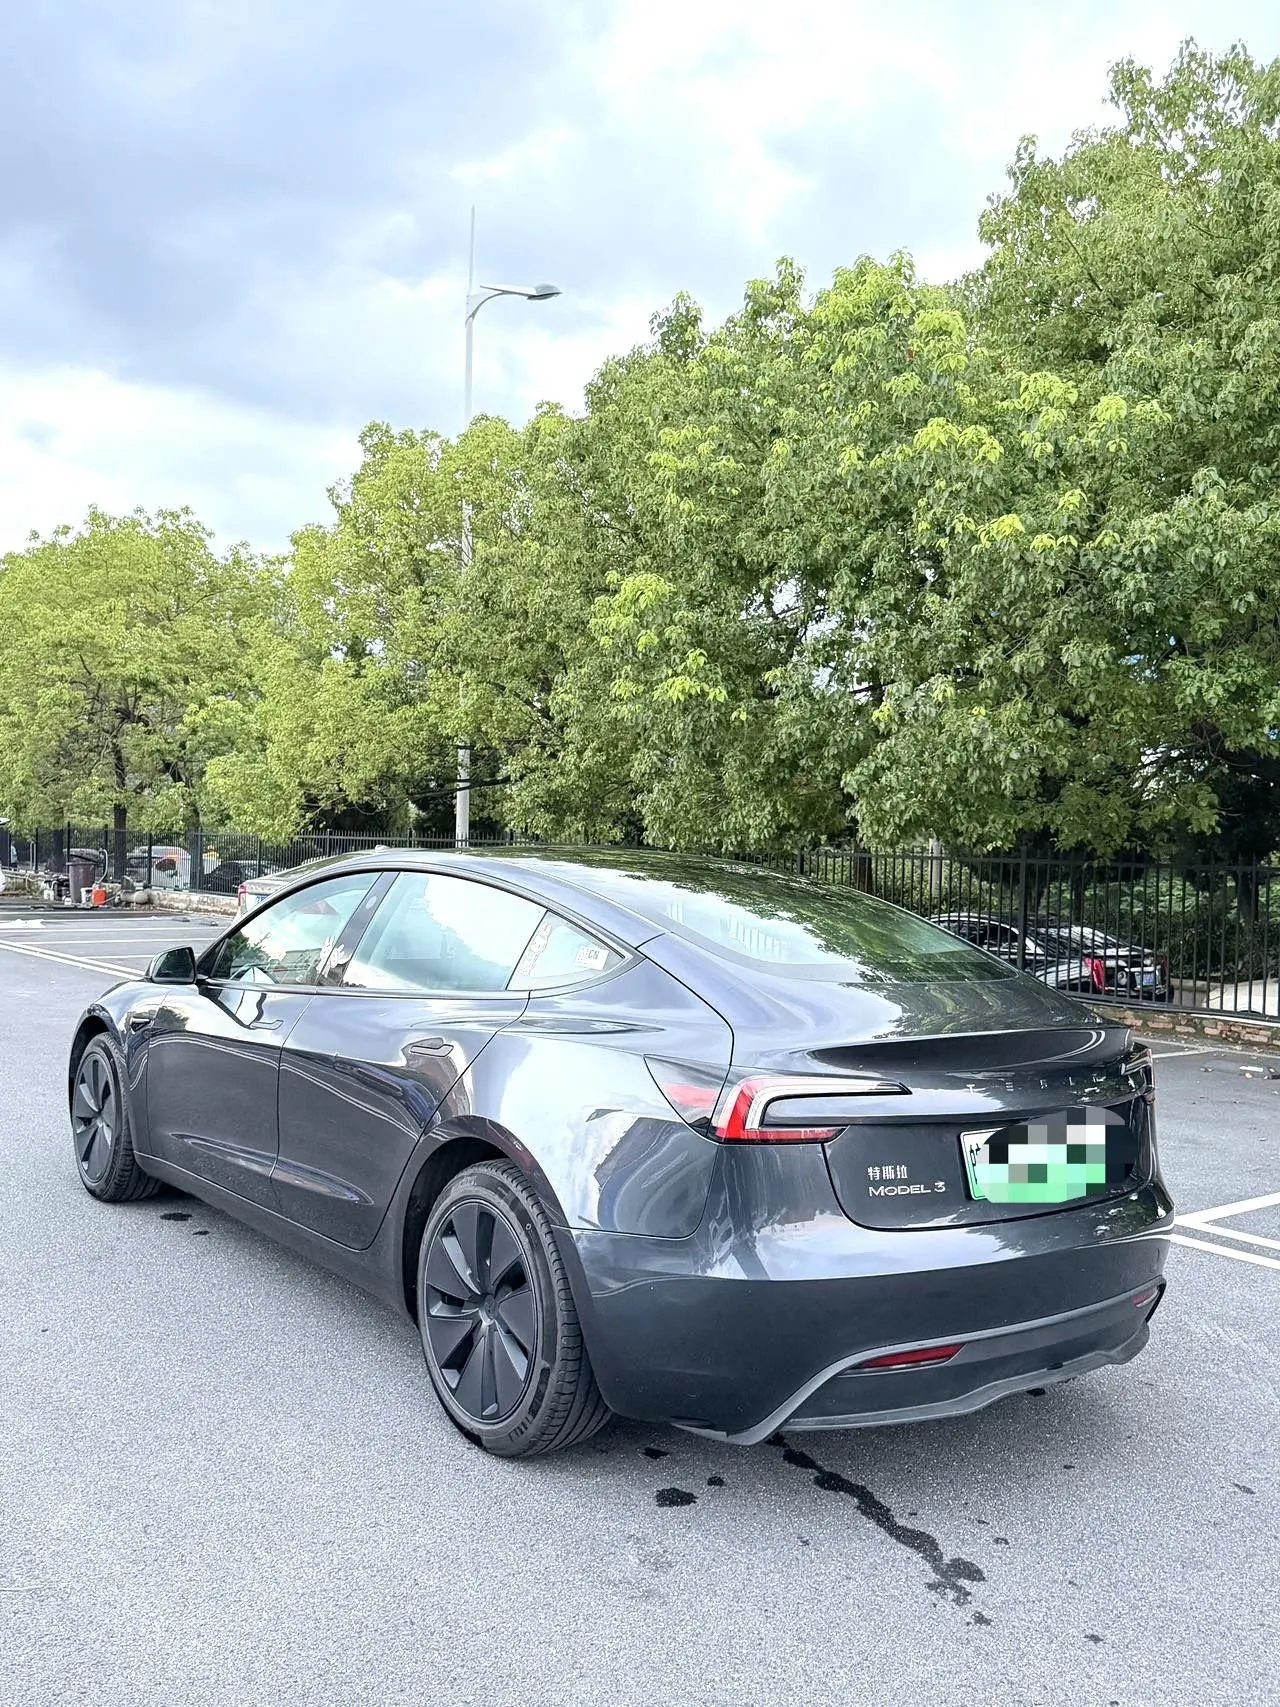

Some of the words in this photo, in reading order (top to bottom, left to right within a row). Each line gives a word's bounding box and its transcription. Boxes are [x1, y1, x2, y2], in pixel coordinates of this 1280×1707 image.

[867, 1165, 908, 1180] 特斯拉
[868, 1184, 932, 1196] MODEL
[934, 1181, 946, 1192] 3
